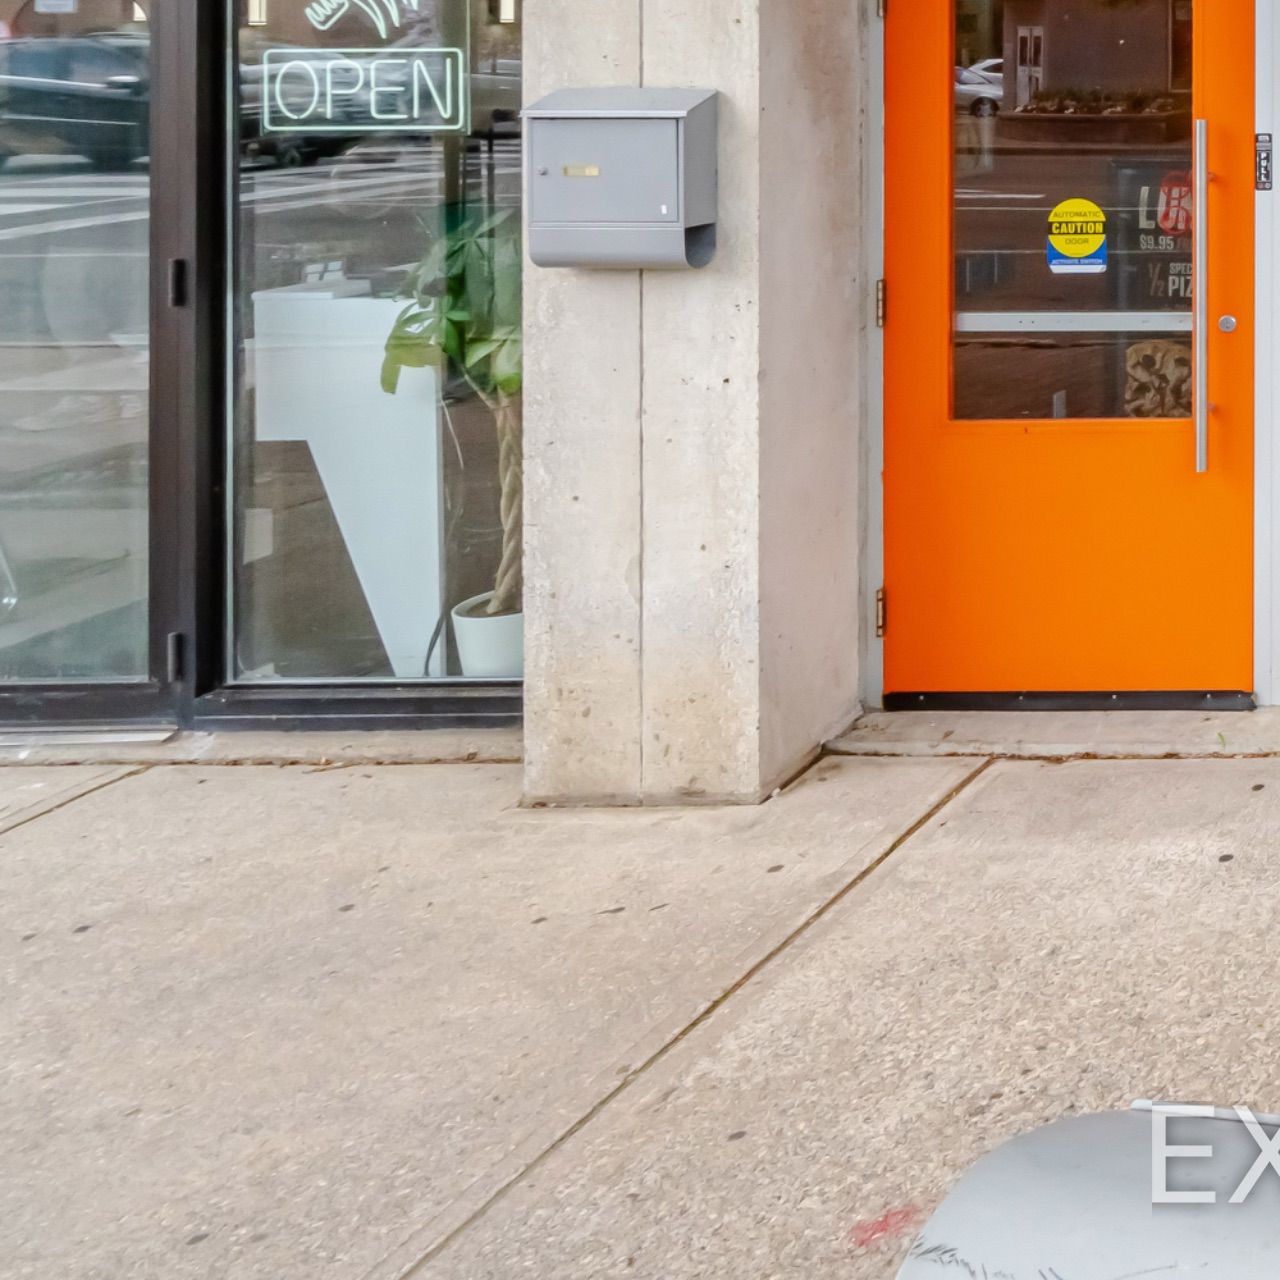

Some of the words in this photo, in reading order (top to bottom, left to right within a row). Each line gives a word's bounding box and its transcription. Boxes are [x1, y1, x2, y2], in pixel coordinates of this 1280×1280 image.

[275, 58, 452, 120] OPEN
[1053, 210, 1101, 218] AUTOMATIC
[1051, 222, 1103, 234] CAUTION
